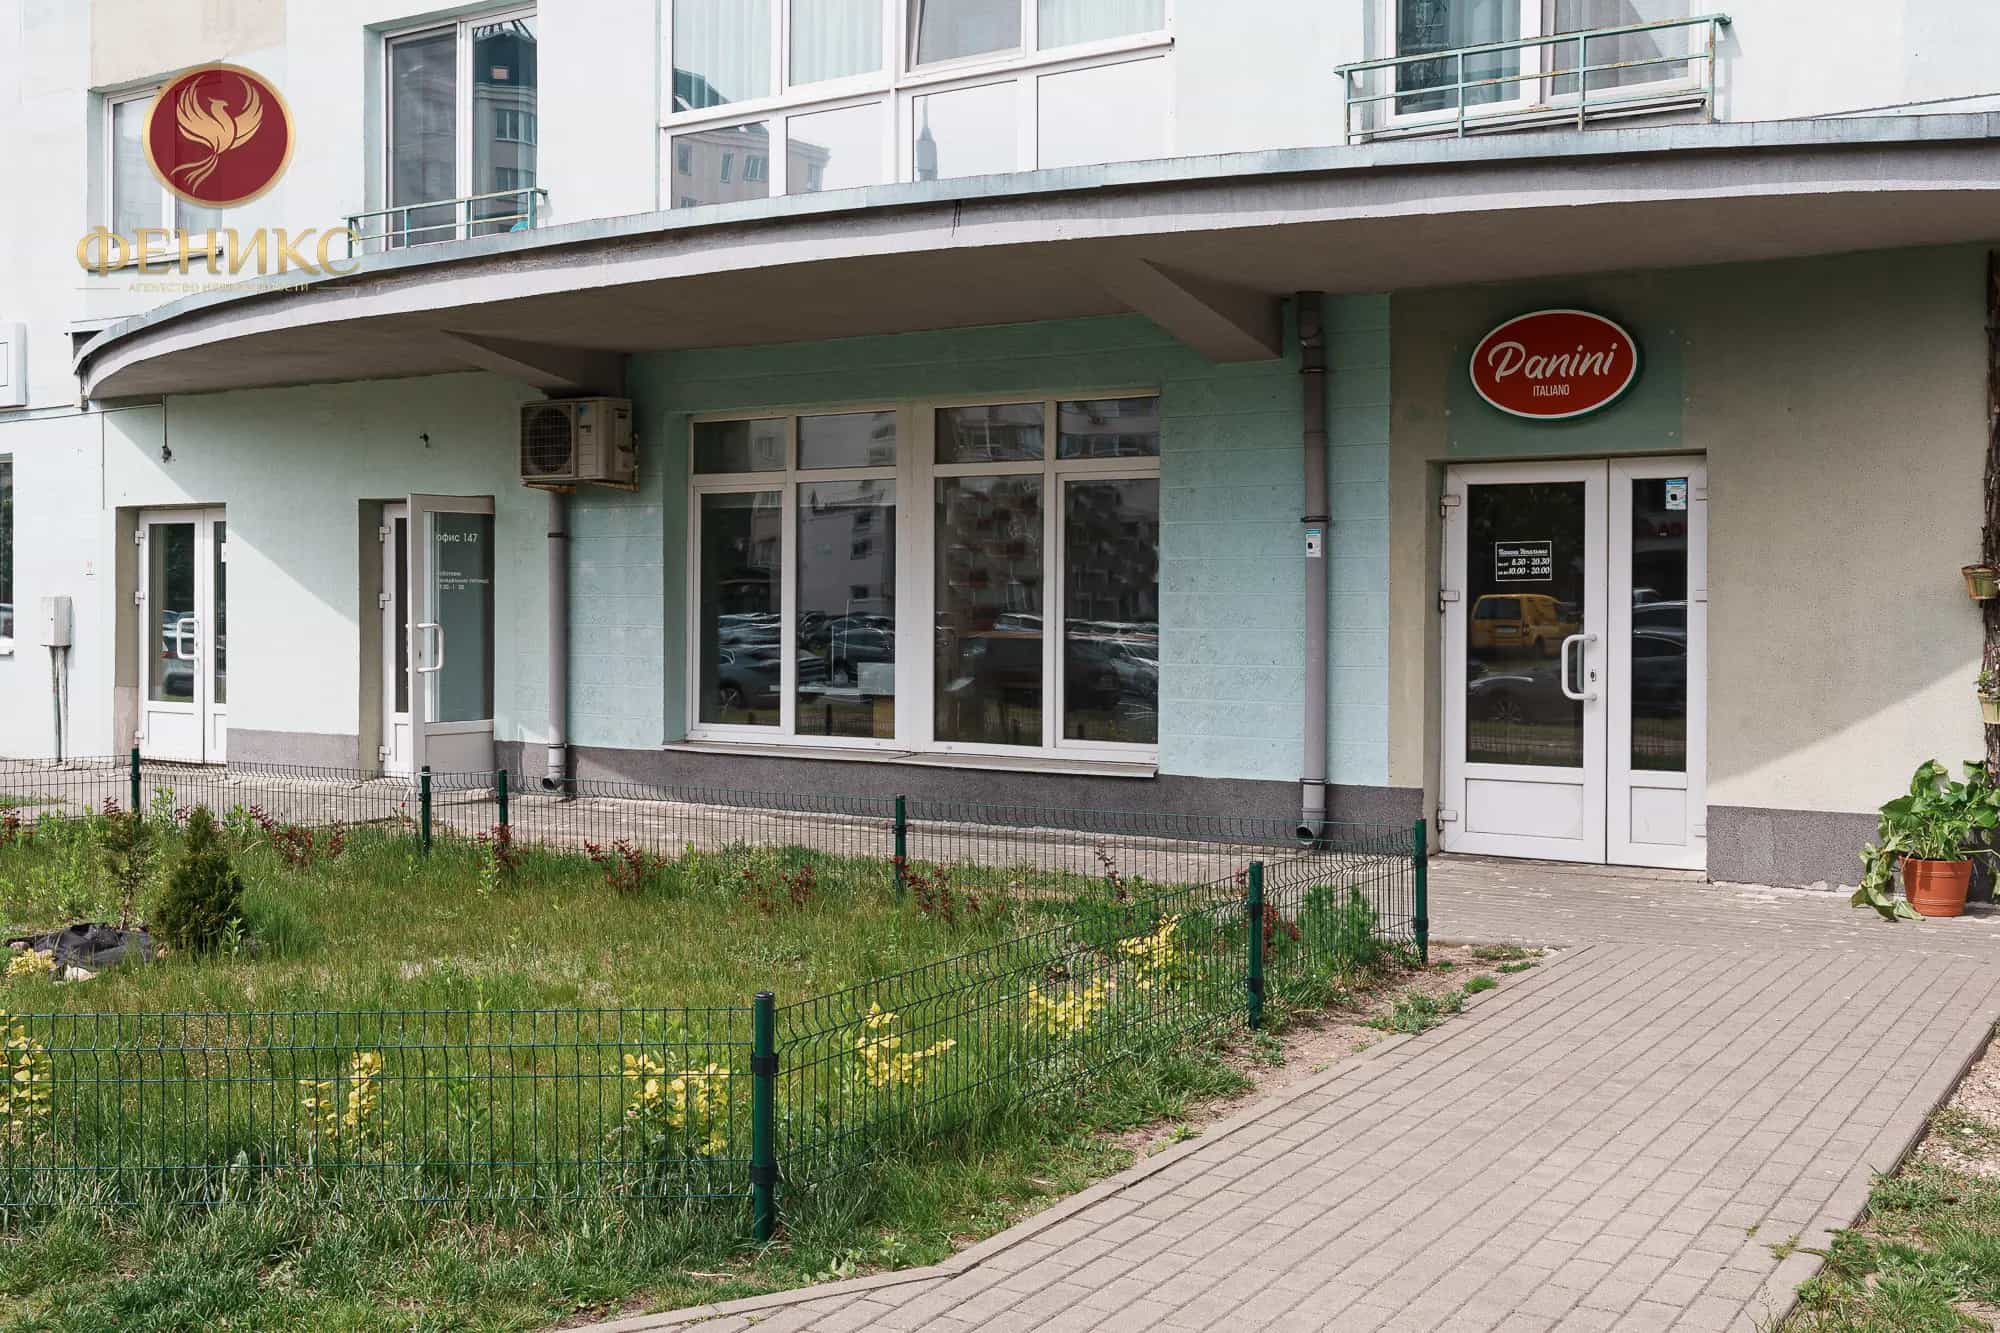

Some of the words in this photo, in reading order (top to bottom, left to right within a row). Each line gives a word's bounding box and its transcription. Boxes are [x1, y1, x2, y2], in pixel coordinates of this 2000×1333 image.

[1488, 341, 1618, 383] Panini
[1533, 384, 1570, 397] ITALIANO
[463, 532, 479, 543] 147
